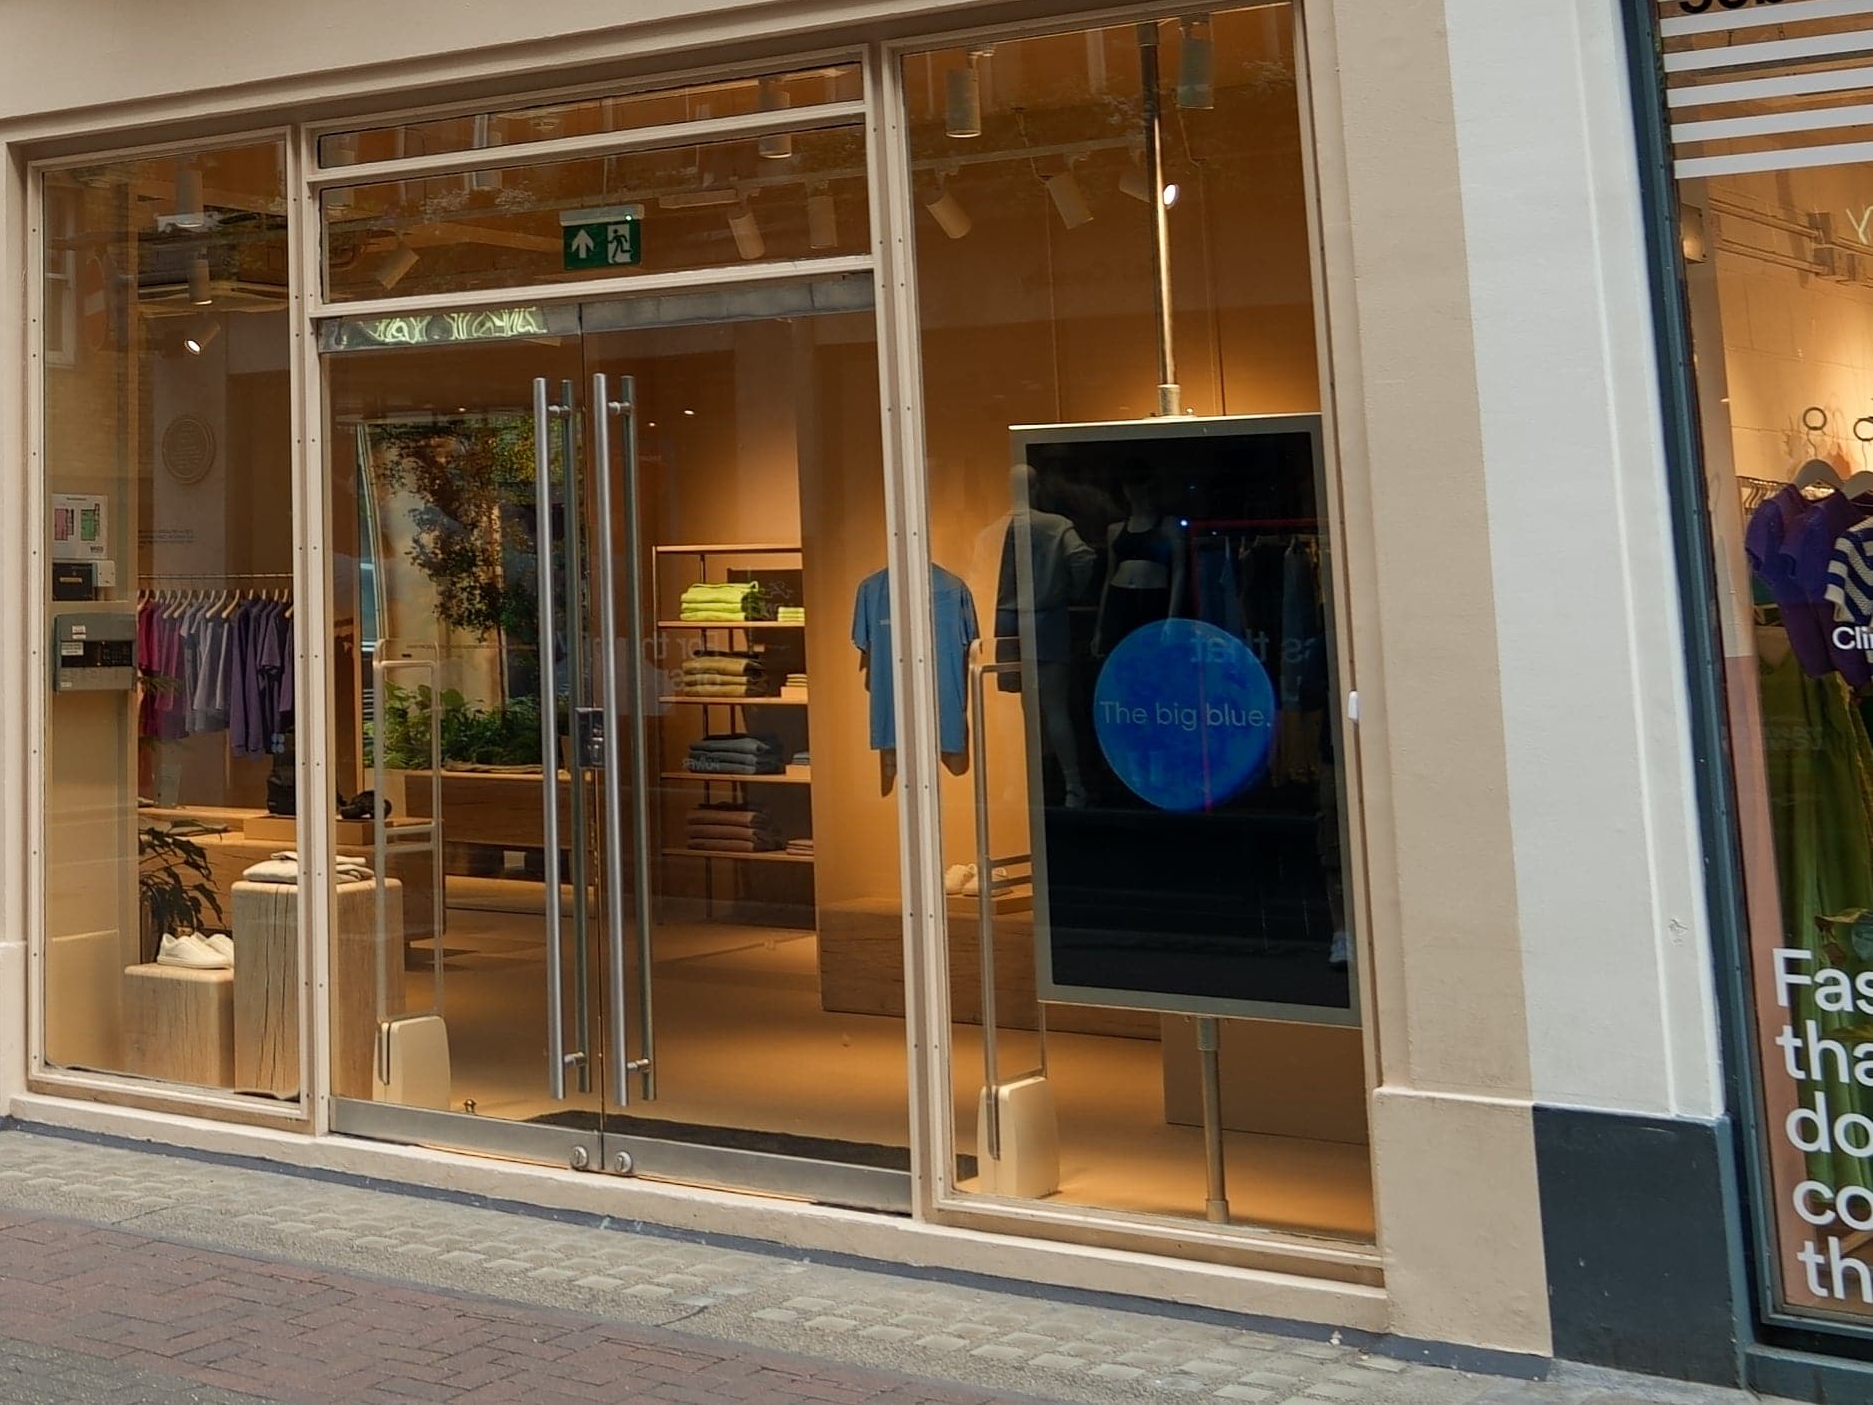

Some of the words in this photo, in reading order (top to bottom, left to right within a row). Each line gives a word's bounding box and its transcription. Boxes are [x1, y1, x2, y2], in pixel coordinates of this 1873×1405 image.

[1832, 626, 1873, 650] Cli
[1100, 700, 1148, 724] The
[1156, 702, 1197, 731] big
[1206, 702, 1272, 728] blue.
[1785, 1091, 1873, 1158] do
[1792, 1179, 1873, 1231] co
[1796, 1235, 1873, 1304] th
